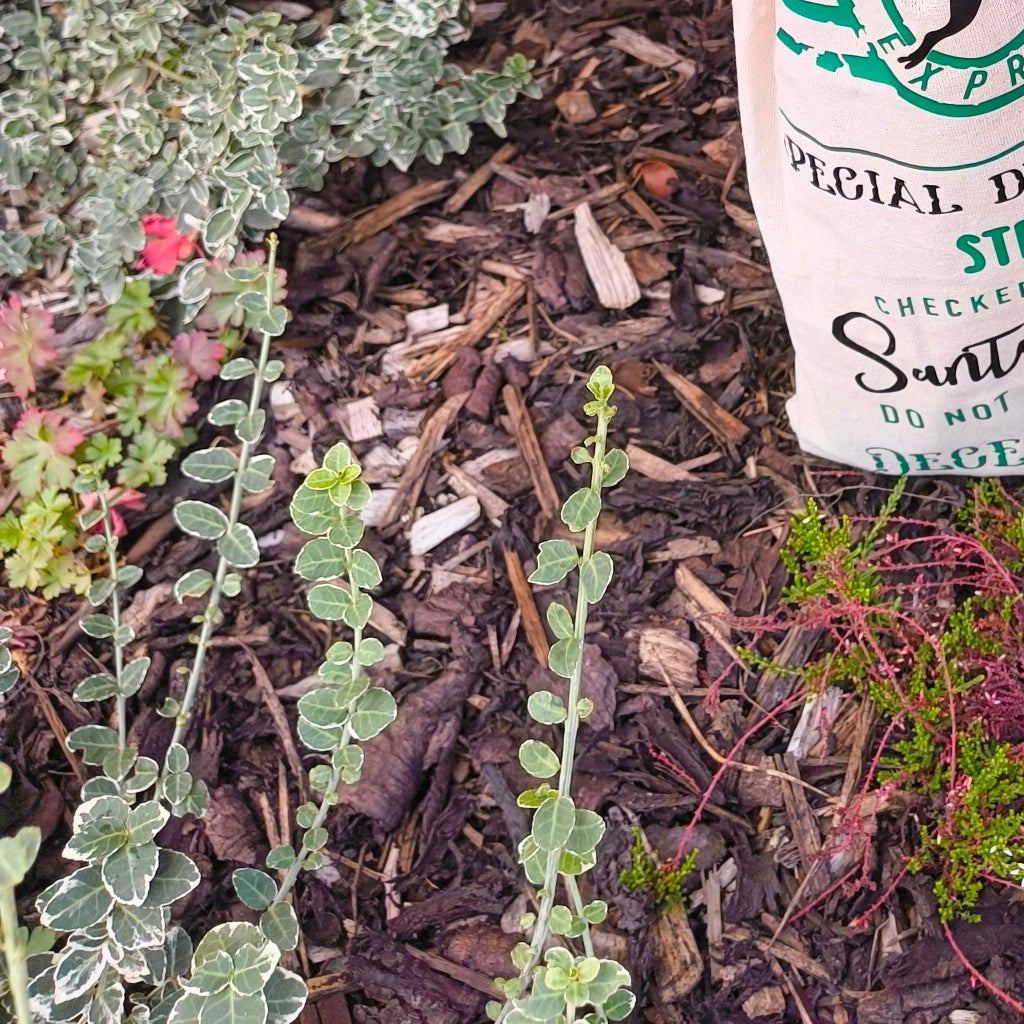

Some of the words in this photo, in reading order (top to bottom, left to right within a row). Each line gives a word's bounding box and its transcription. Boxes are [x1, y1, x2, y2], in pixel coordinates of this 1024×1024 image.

[784, 134, 964, 215] PECIAL
[879, 403, 925, 429] DO
[944, 391, 1009, 426] NOT
